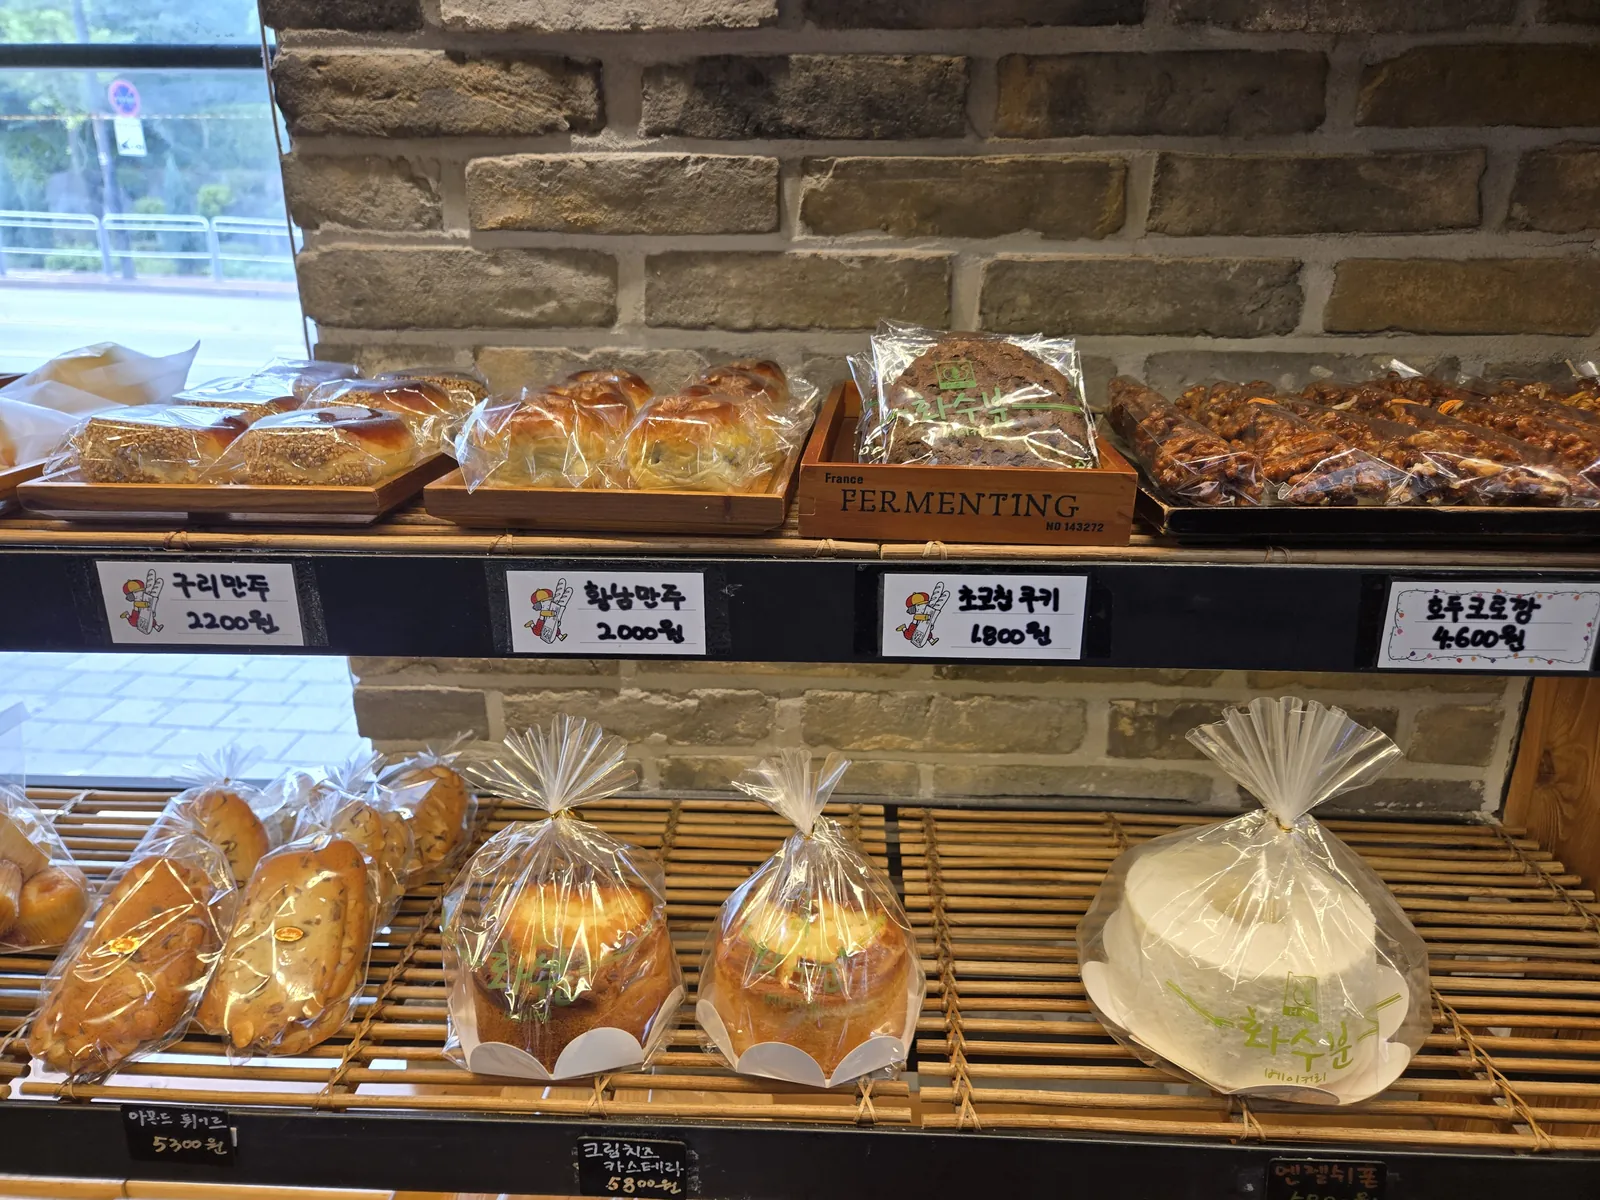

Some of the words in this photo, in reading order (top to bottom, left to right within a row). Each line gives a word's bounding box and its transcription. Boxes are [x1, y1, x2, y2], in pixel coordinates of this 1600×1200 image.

[824, 472, 864, 485] France
[840, 488, 1080, 518] FERMENTING
[1063, 522, 1104, 533] 143272
[584, 580, 686, 612] 황남만주
[1018, 585, 1060, 613] 쿠키
[186, 609, 280, 635] 2200원
[596, 619, 685, 644] 2000원
[1240, 1005, 1354, 1073] 화수분
[603, 1160, 684, 1178] 카스테라
[605, 1176, 682, 1195] 5800원
